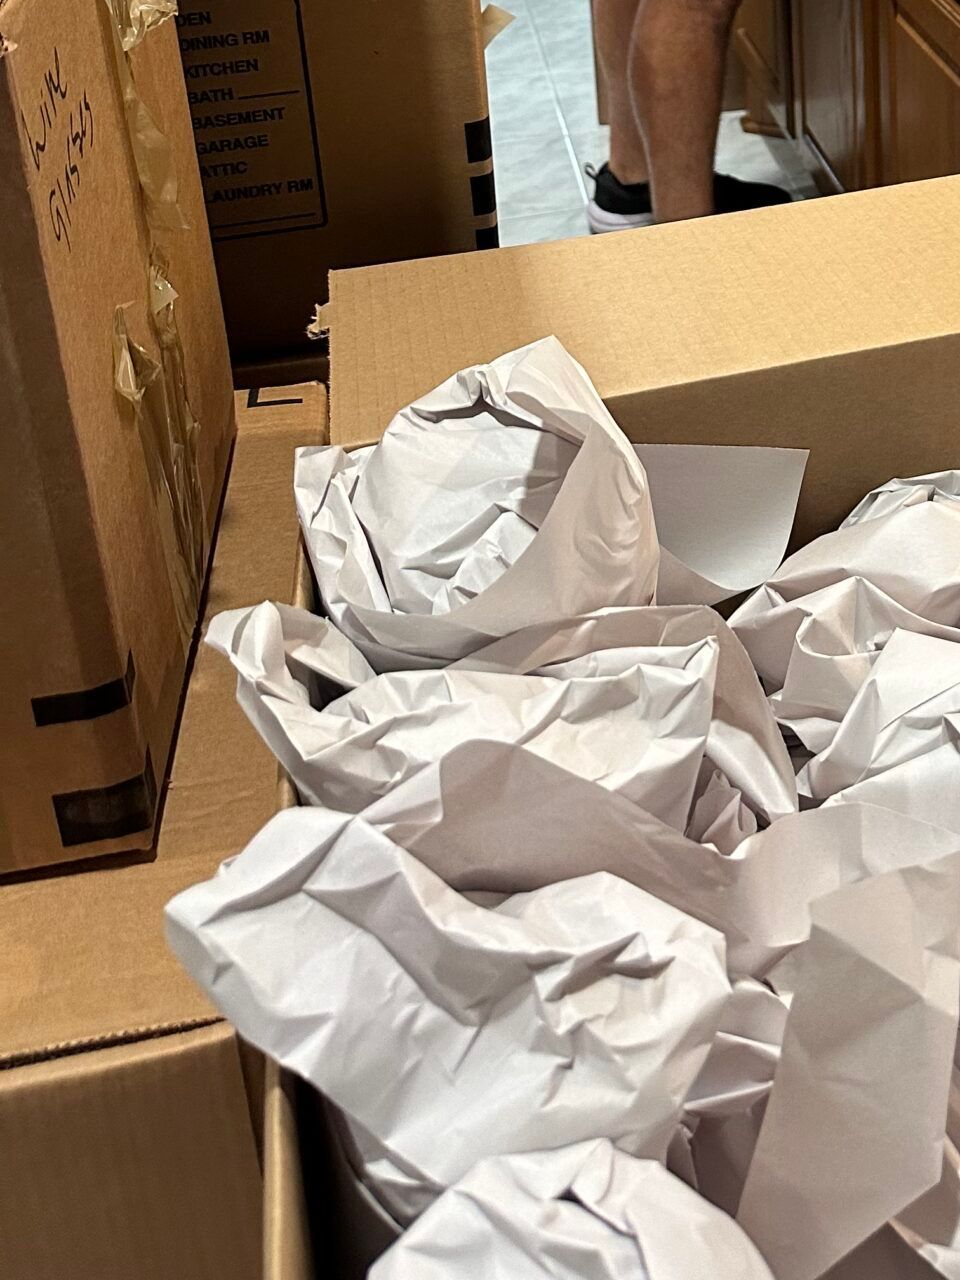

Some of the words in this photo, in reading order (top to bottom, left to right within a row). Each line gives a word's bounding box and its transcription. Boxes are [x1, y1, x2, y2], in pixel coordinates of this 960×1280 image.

[176, 11, 212, 28] DEN
[180, 32, 239, 52] DINING
[241, 29, 270, 45] RM
[184, 58, 259, 80] KITCHEN
[188, 87, 234, 105] BATH
[193, 106, 286, 130] BASEMENT
[197, 134, 270, 156] GARAGE
[201, 160, 248, 179] ATTIC
[205, 181, 283, 204] LAUNDRY
[287, 177, 314, 194] RM
